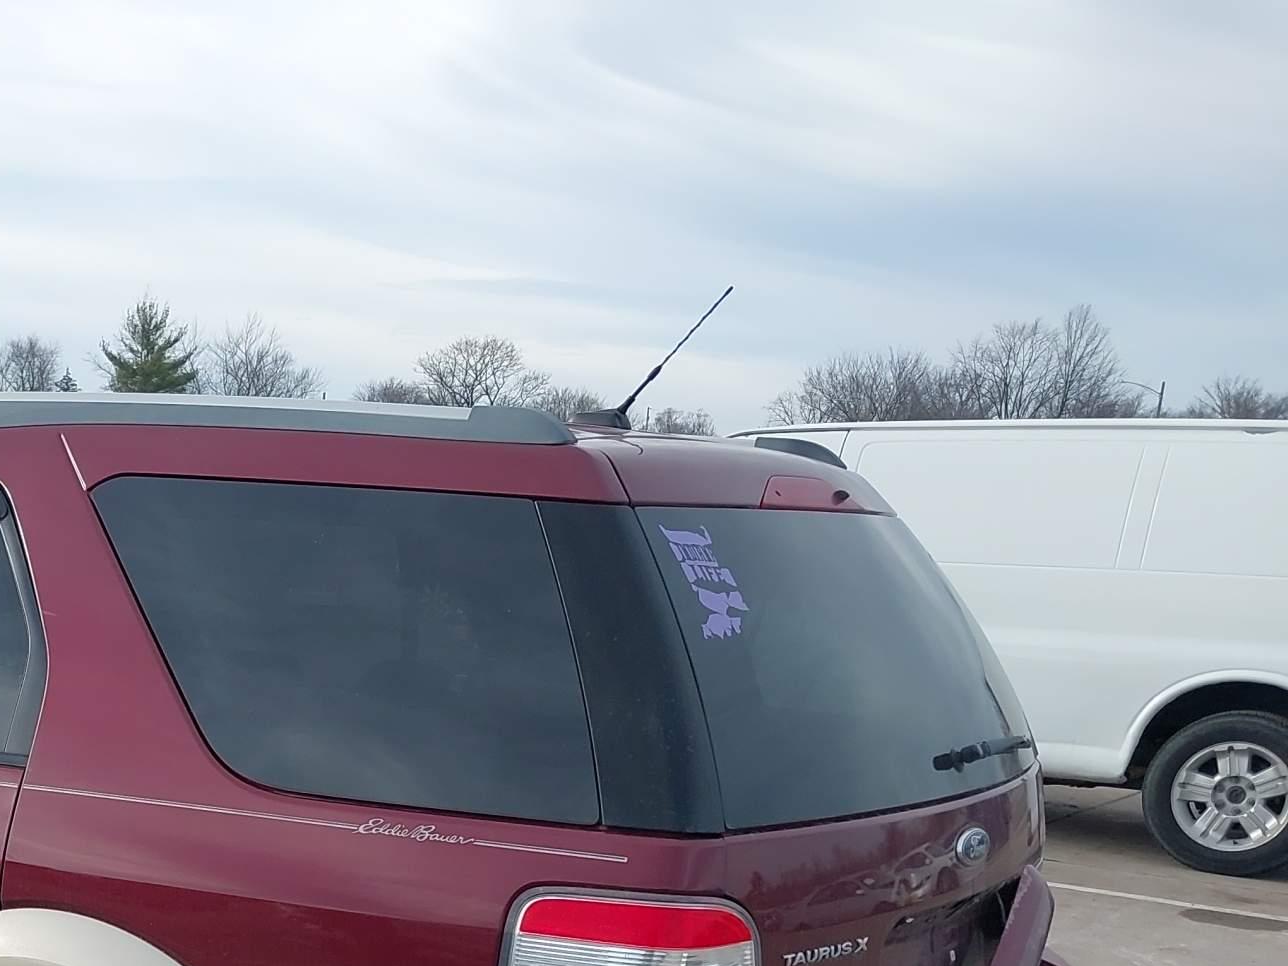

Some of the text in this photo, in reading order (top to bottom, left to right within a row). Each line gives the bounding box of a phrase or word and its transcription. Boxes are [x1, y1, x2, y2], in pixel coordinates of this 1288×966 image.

[353, 818, 473, 845] Eddie Bauer
[854, 936, 869, 953] X
